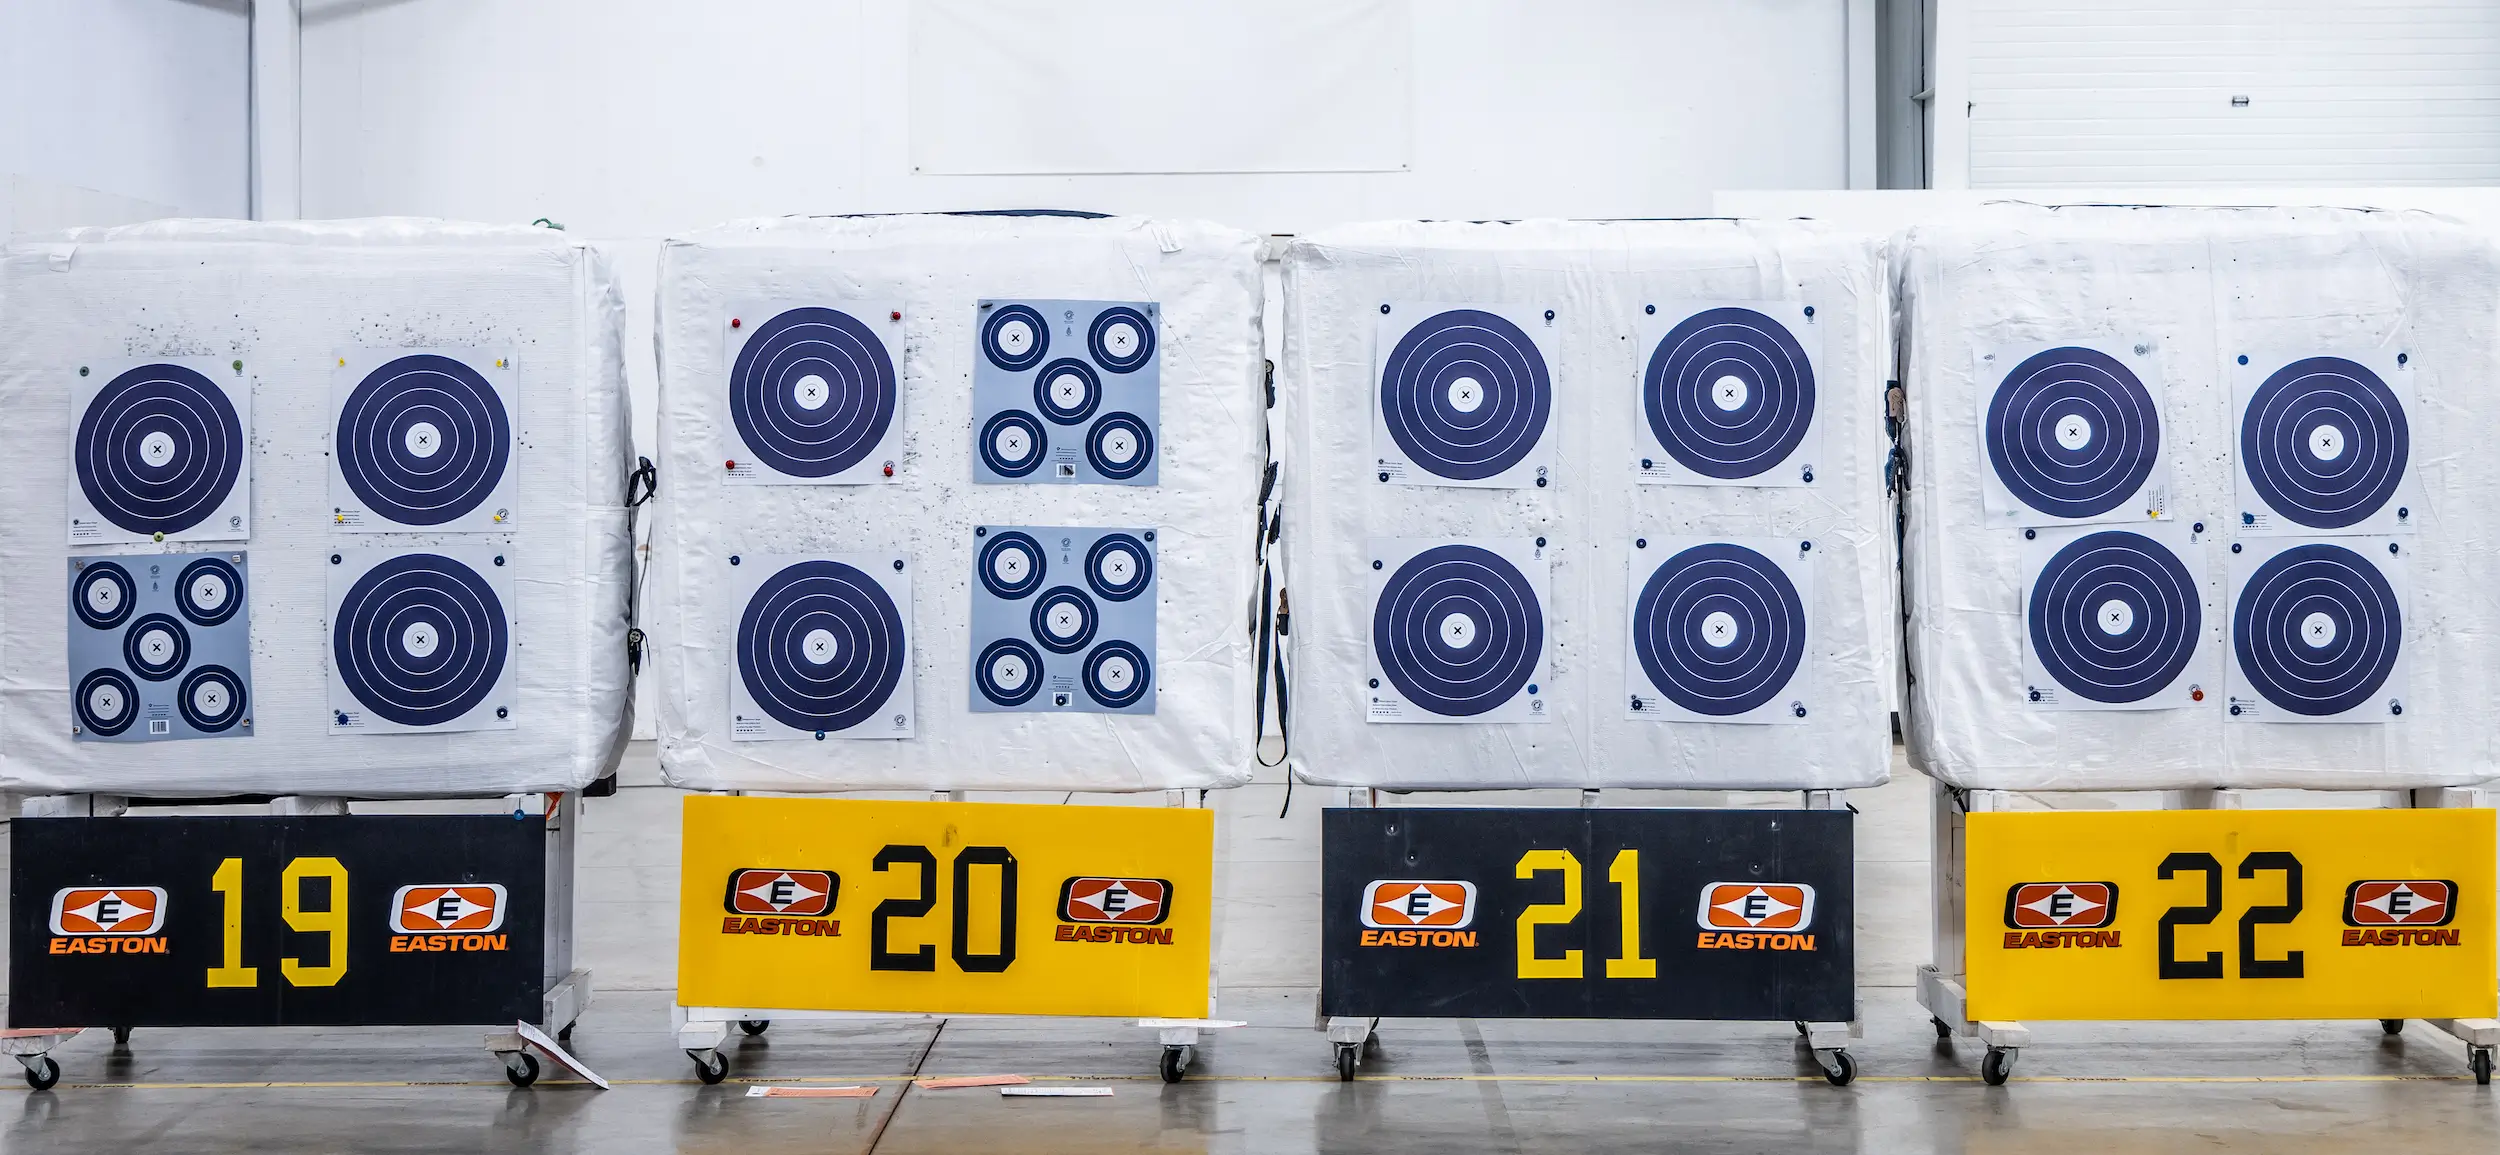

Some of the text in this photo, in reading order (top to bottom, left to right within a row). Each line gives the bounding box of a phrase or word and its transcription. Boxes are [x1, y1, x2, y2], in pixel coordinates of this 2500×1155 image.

[769, 881, 795, 904] E
[1103, 889, 1128, 912] E
[2389, 892, 2413, 915] E
[96, 900, 120, 923] E
[438, 898, 461, 920] E
[871, 845, 1017, 972] 20
[1407, 894, 1431, 915] E
[1516, 850, 1656, 978] 21
[1744, 896, 1768, 918] E
[2050, 894, 2074, 917] E
[2158, 852, 2304, 979] 22
[207, 857, 348, 987] 19
[722, 917, 840, 936] EASTON
[50, 937, 167, 954] EASTON
[390, 935, 506, 952] EASTON
[1055, 925, 1173, 944] EASTON
[1360, 930, 1477, 947] EASTON
[1697, 933, 1815, 950] EASTON
[2003, 931, 2121, 949] EASTON
[2341, 929, 2460, 946] EASTON
